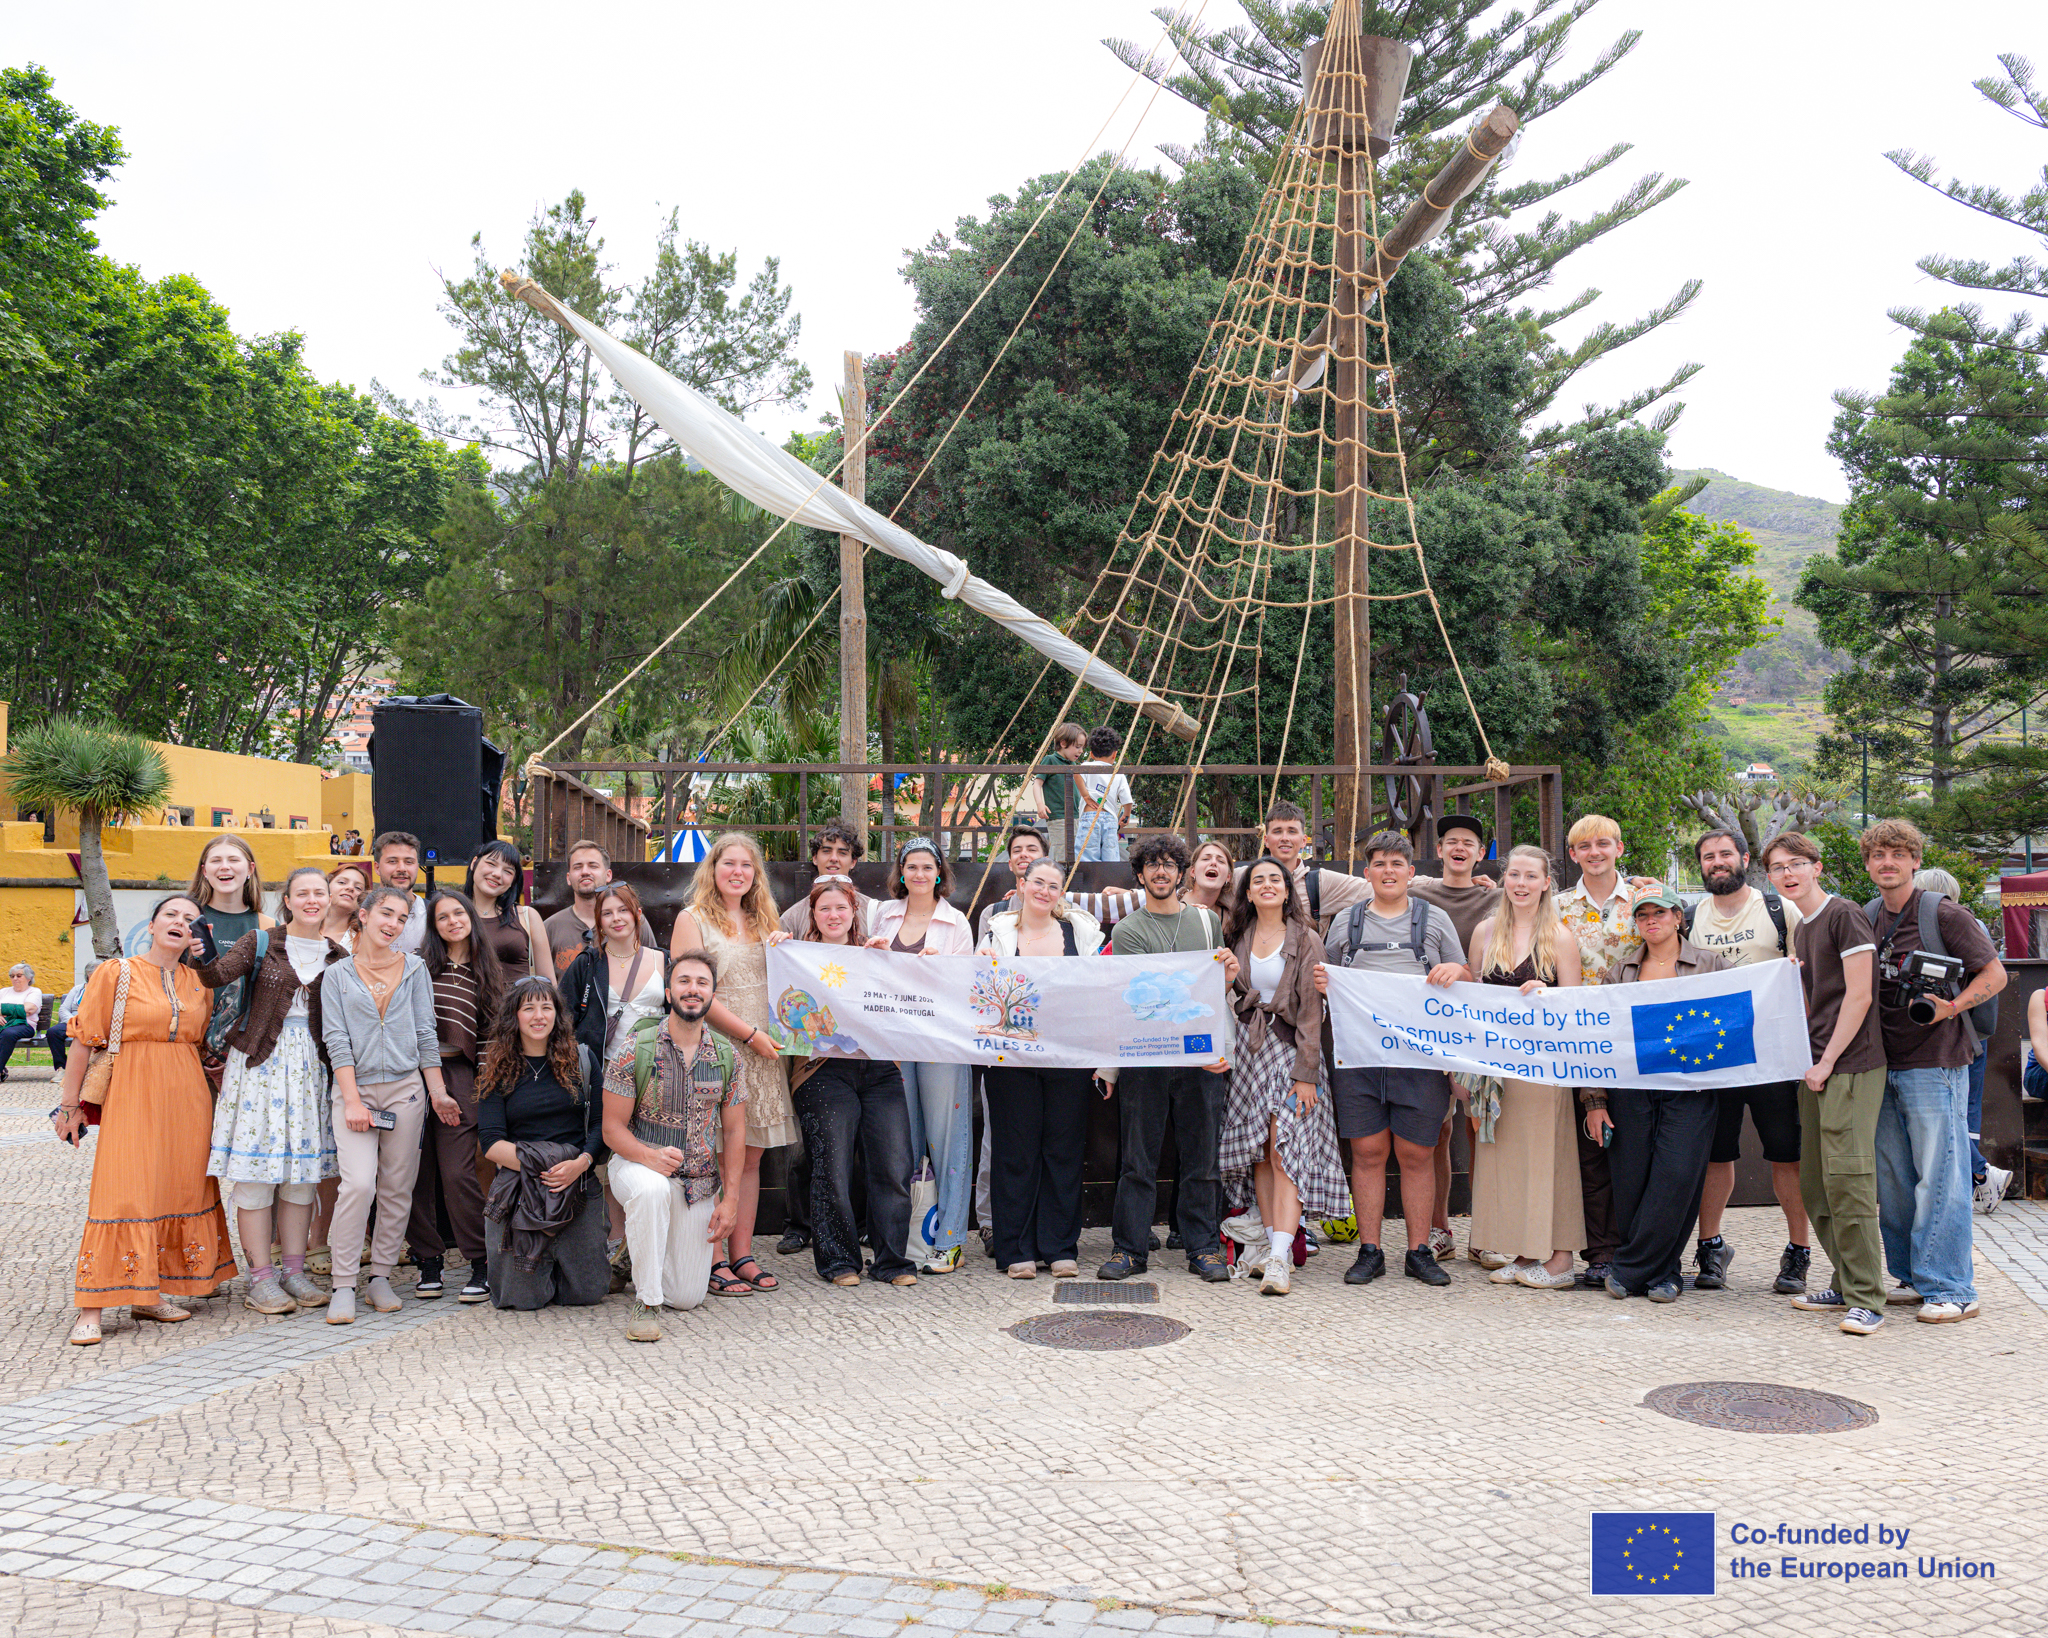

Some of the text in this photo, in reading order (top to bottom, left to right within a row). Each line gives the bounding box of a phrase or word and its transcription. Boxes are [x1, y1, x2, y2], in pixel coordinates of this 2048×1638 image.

[582, 983, 590, 1003] SONY
[900, 994, 917, 1002] JUNE
[863, 1004, 936, 1017] MADEIRA, PORTUGAL
[1424, 998, 1611, 1031] Co-funded by the
[1372, 1013, 1613, 1055] Esmus+ Programme
[973, 1038, 1045, 1052] TALES 2.0
[1552, 1061, 1617, 1079] Union
